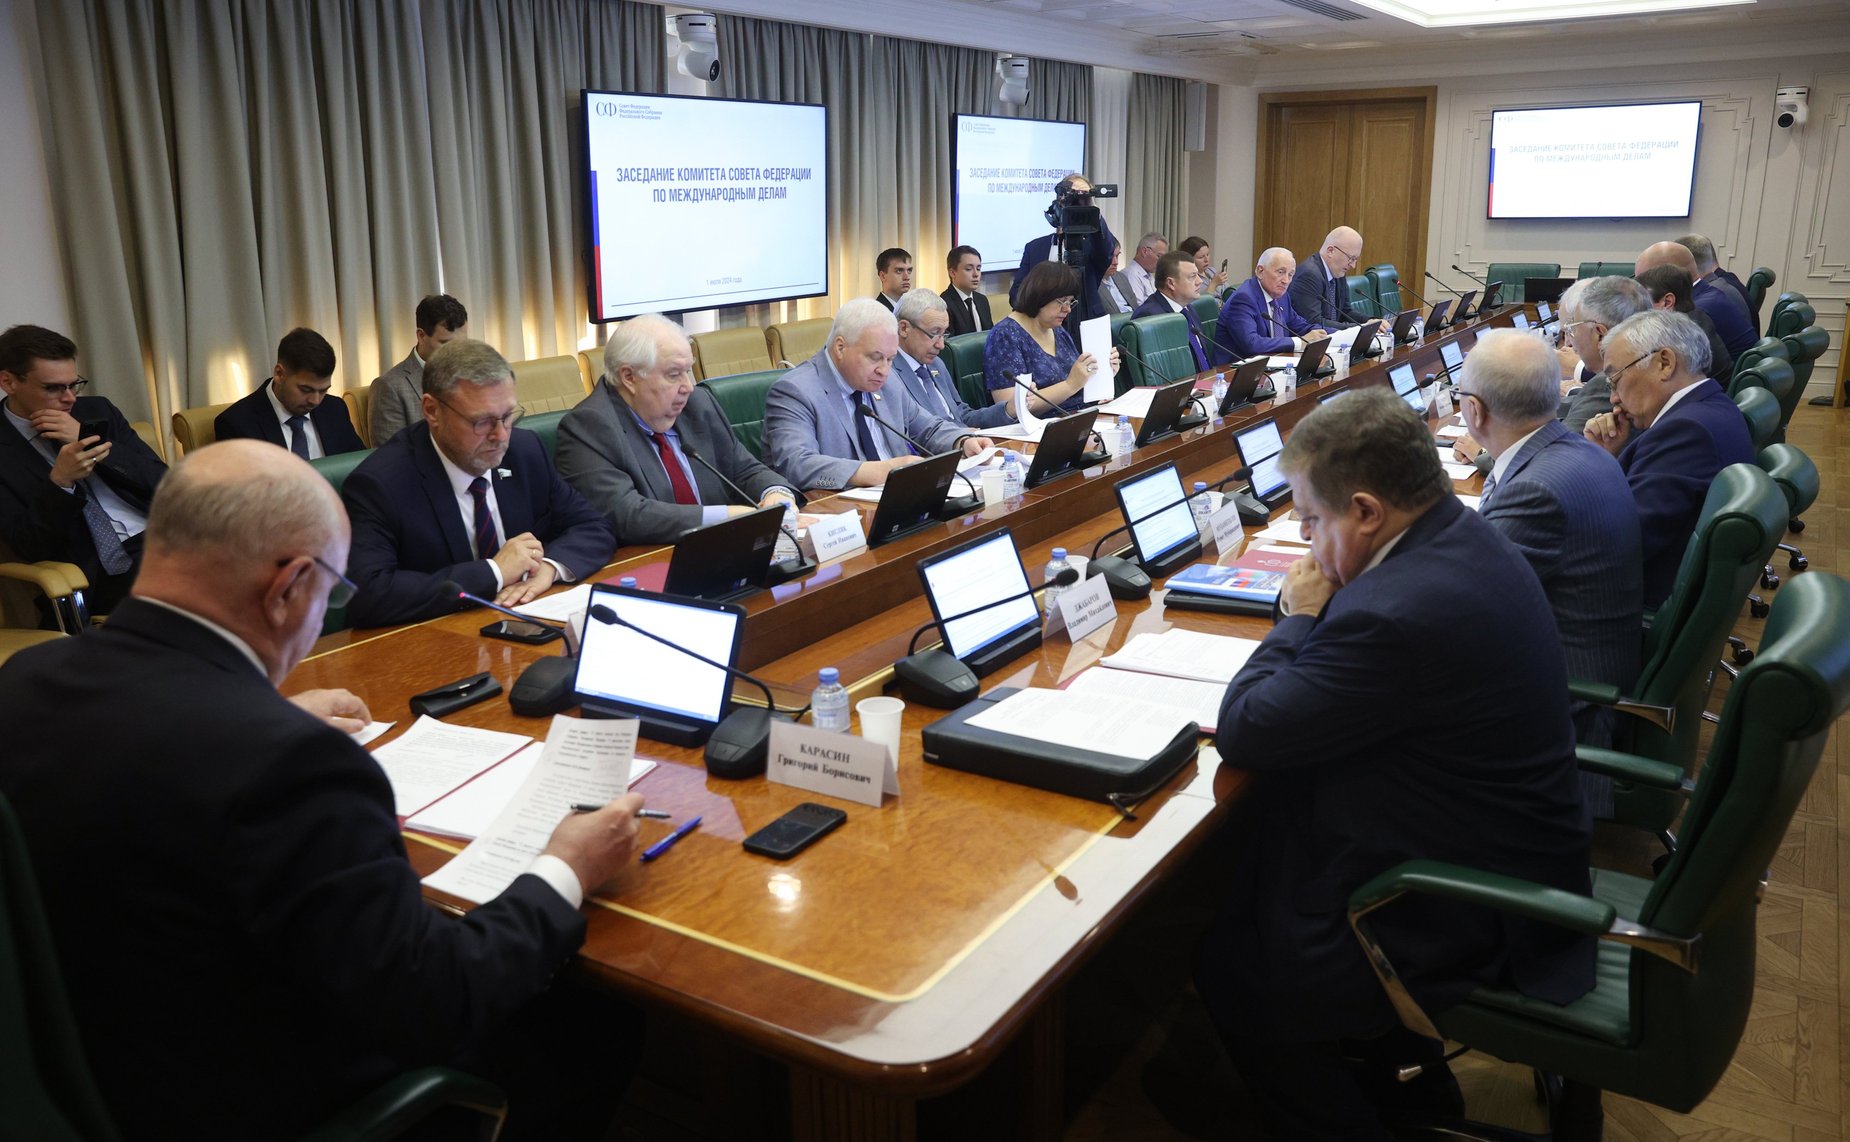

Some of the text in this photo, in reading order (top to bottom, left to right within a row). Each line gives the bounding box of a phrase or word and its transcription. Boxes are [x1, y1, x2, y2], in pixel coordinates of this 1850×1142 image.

[617, 167, 812, 184] ЗАСЕДАНИЕ КОМИТЕТА СОВЕТА ФЕДЕРАЦИИ
[653, 186, 787, 204] ПО МЕЖДУНАРОДНЫМ ДЕЛАМ
[800, 743, 850, 764] КАРАСИН
[777, 753, 871, 784] Григорий Борисович
